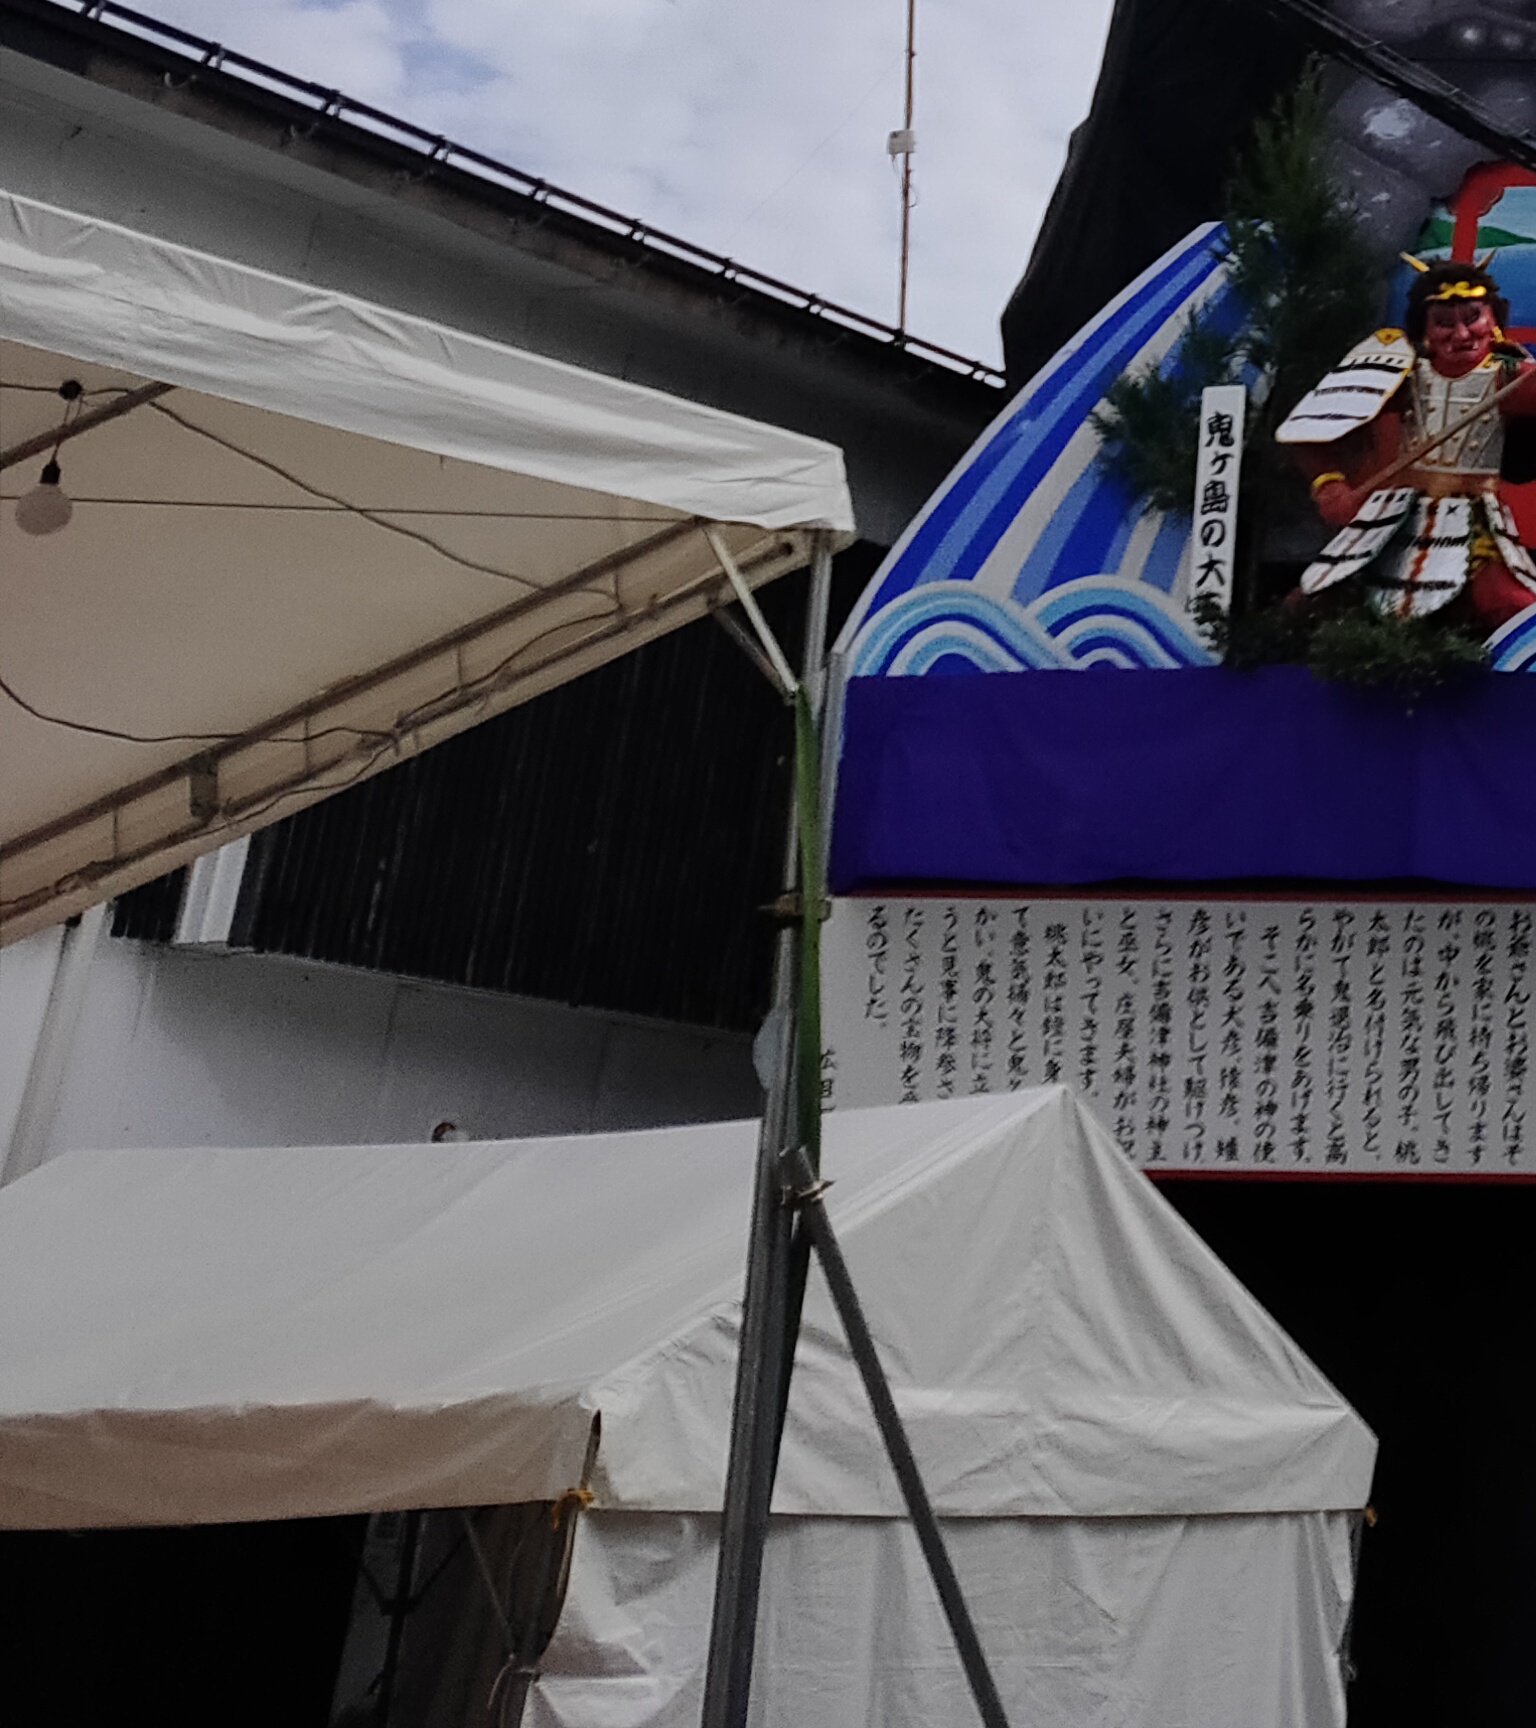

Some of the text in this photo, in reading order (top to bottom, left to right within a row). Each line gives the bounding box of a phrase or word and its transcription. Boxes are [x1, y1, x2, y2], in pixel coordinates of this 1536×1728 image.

[1194, 411, 1236, 604] 鬼ヶ島の大
